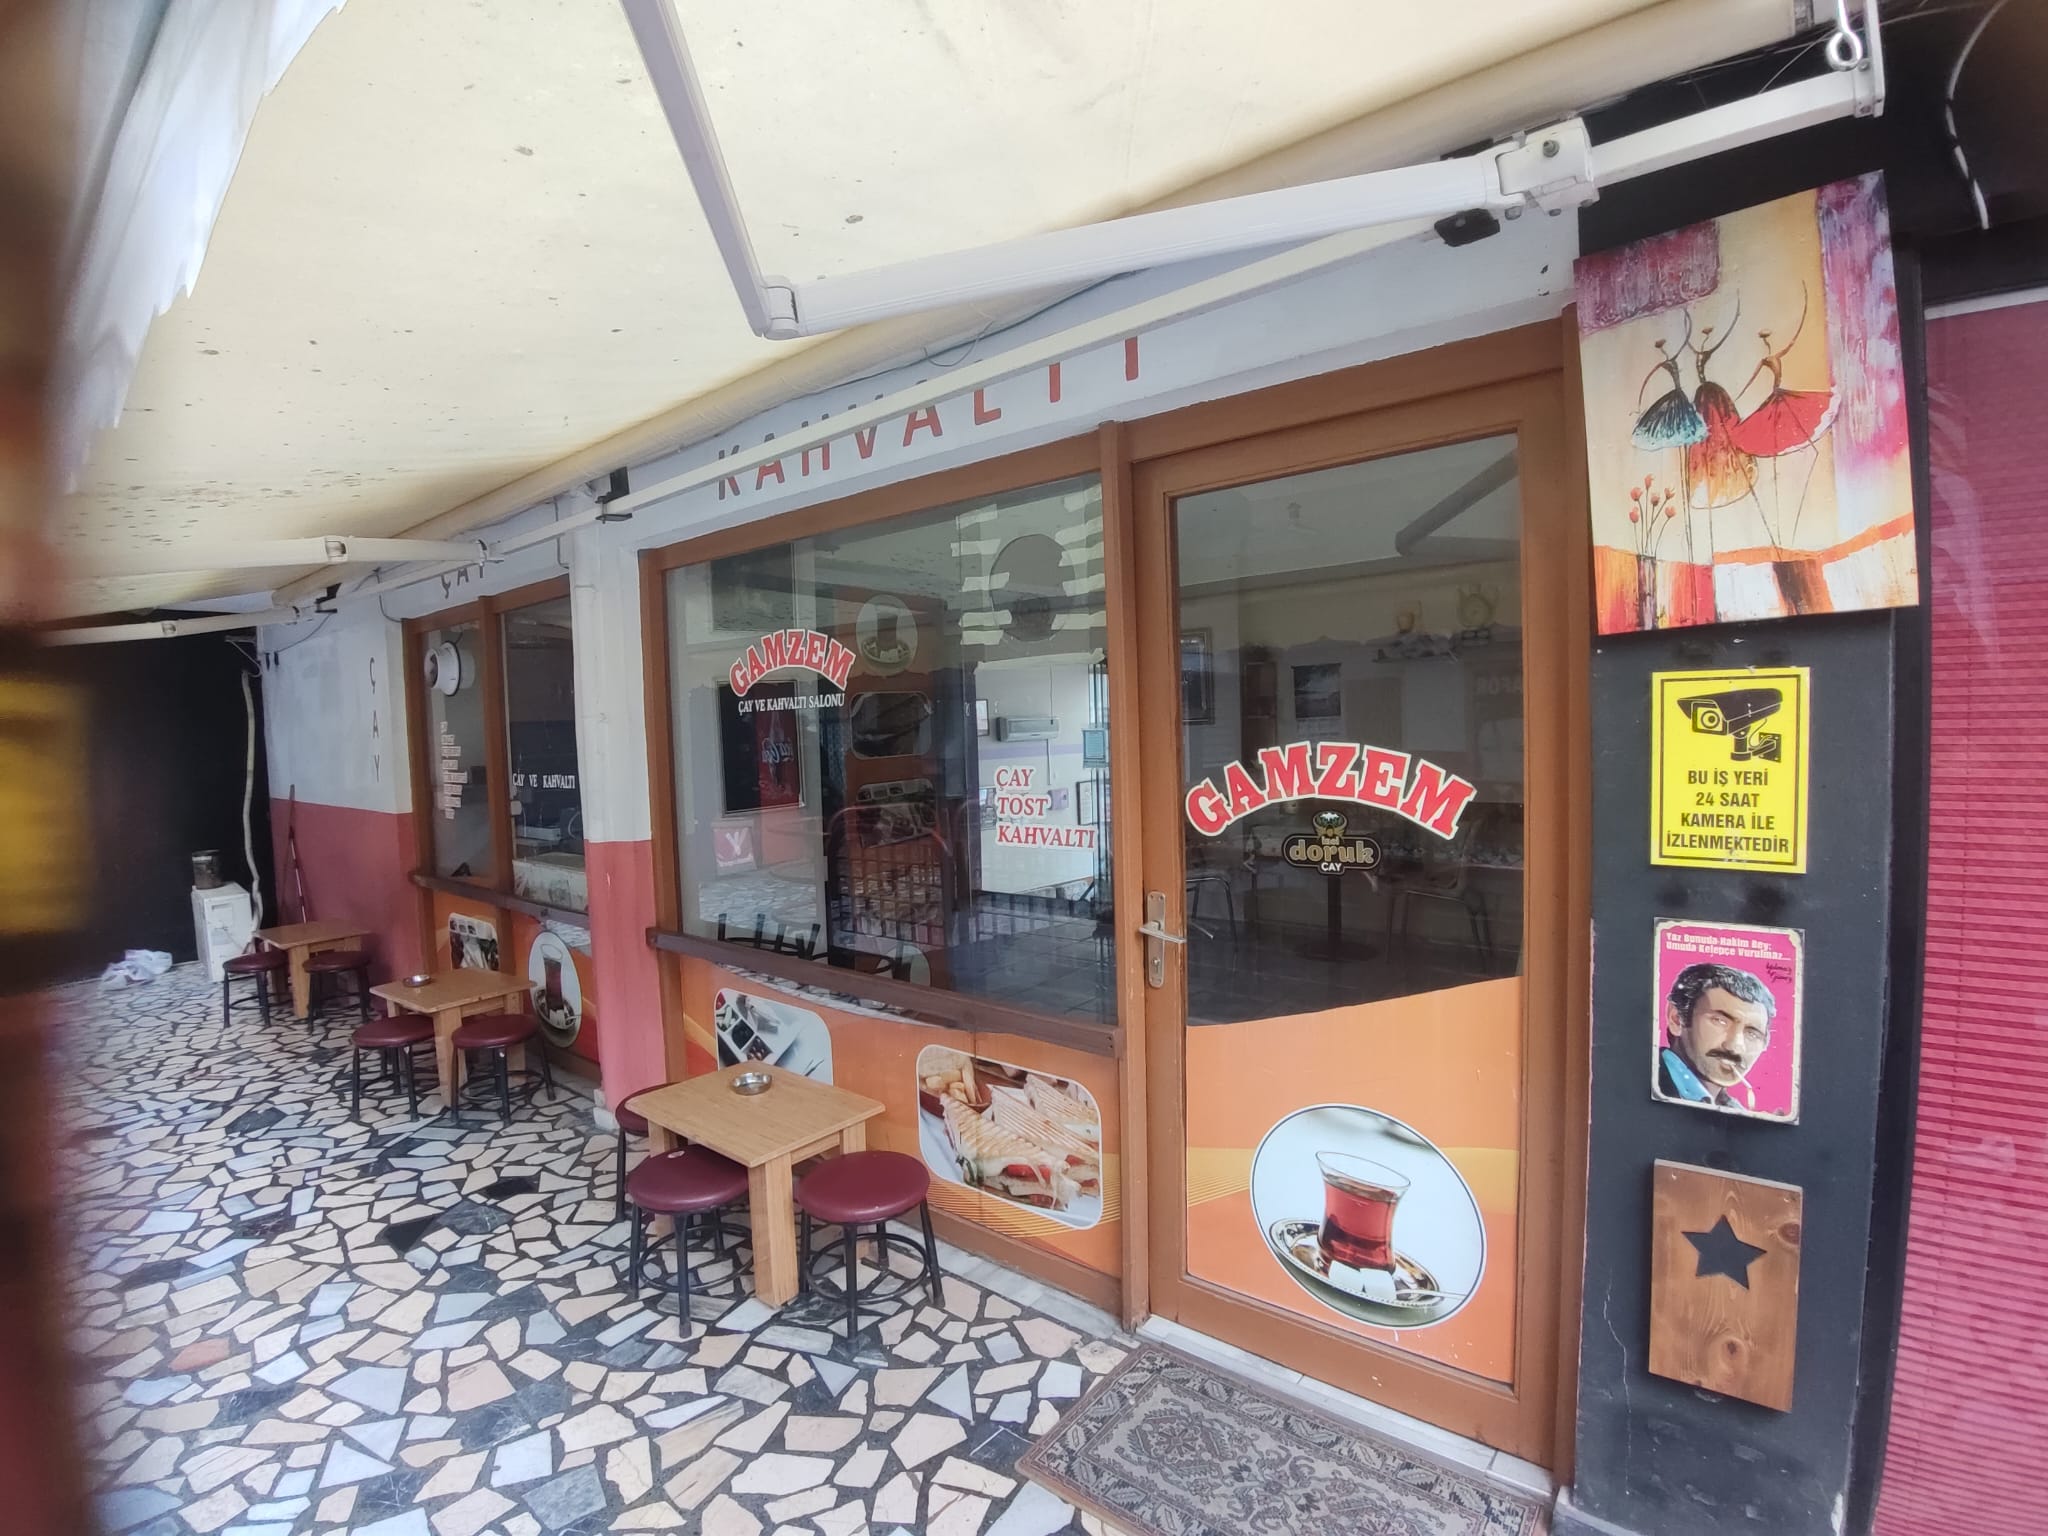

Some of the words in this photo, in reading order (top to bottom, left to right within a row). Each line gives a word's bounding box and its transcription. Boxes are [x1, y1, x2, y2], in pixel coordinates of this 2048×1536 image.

[729, 629, 856, 697] GAMZEM
[738, 700, 754, 716] ÇAY
[755, 699, 766, 712] VE
[767, 696, 807, 711] KAHVALTI
[809, 693, 845, 708] SALONU
[369, 657, 380, 783] ÇAY
[529, 774, 538, 788] VE
[542, 774, 576, 789] KAHVALTI
[996, 768, 1034, 790] ÇAY
[1688, 770, 1708, 785] BU
[1714, 768, 1728, 787] İŞ
[1734, 768, 1768, 786] YERİ
[1186, 741, 1477, 840] GAMZEM
[1696, 792, 1714, 806] 24
[1720, 792, 1760, 807] SAAT
[997, 797, 1049, 816] TOST
[1681, 812, 1745, 829] KAMERA
[1752, 812, 1775, 830] İLE
[997, 825, 1096, 849] KAHVALTI
[1667, 831, 1789, 853] İZLENMEKTEDİR
[1289, 839, 1374, 863] doruk
